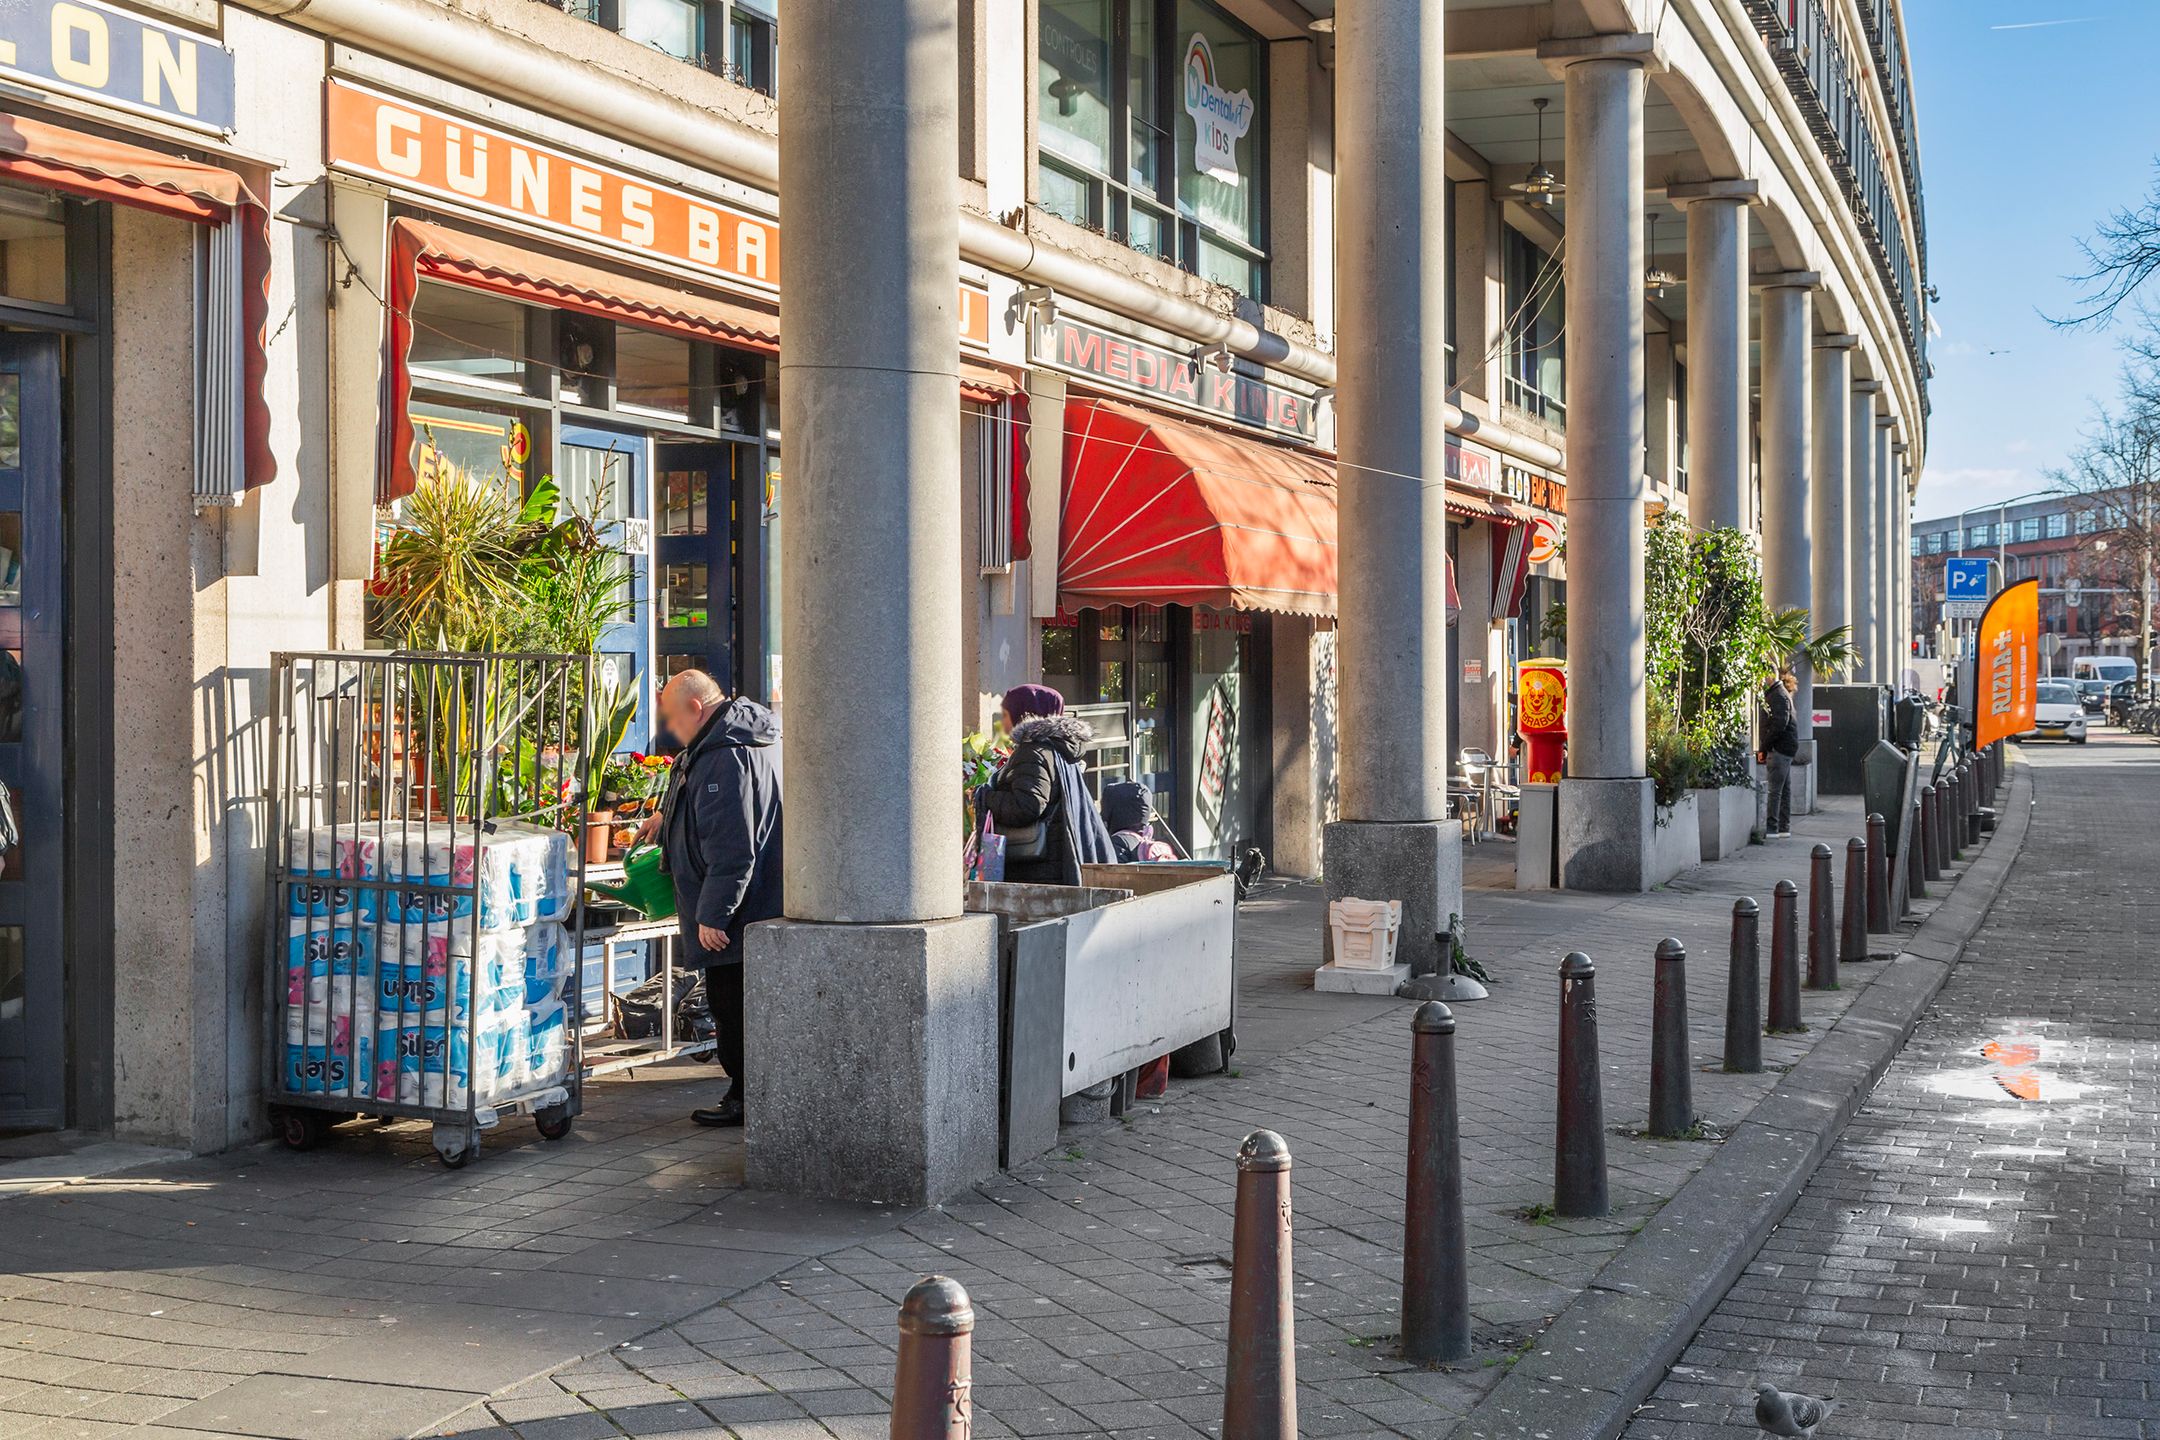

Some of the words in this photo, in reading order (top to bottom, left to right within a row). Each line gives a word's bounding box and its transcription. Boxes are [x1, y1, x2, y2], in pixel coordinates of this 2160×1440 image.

[1063, 325, 1197, 401] MEDIA
[1213, 373, 1299, 428] KING
[1952, 570, 1967, 590] P
[1521, 711, 1556, 728] BRABO
